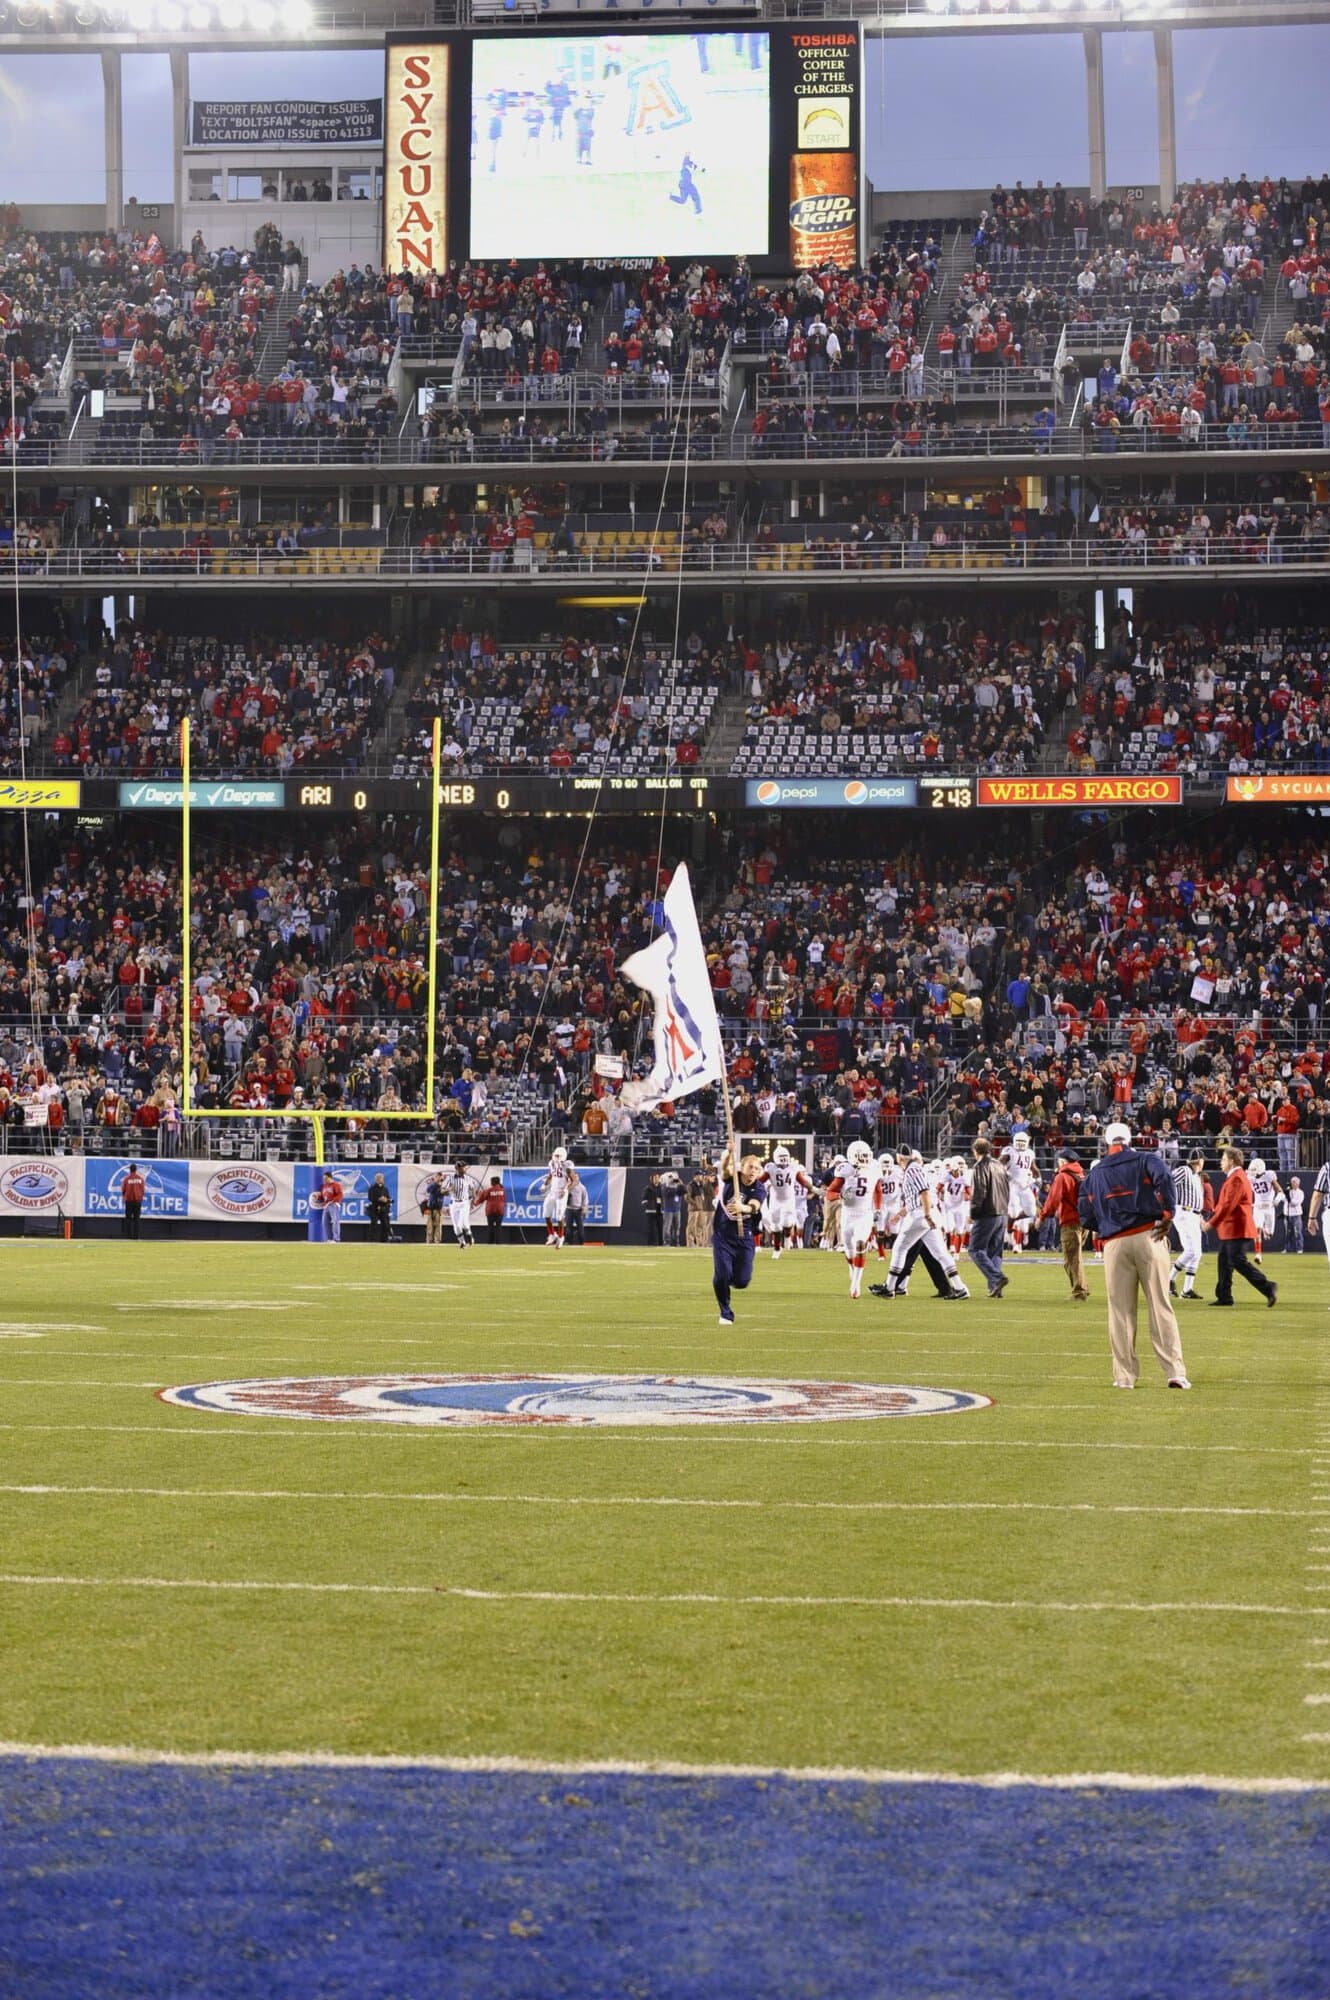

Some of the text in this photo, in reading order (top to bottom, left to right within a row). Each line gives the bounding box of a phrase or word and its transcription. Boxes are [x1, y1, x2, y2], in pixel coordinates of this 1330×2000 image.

[791, 34, 856, 46] TOSHIBA
[798, 48, 849, 58] OFFICIAL
[803, 60, 845, 70] COPIER
[803, 72, 846, 82] OF THE
[794, 84, 854, 94] CHARGERS
[206, 104, 248, 114] REPORT
[250, 104, 272, 114] FAN
[274, 103, 327, 114] CONDUCT
[200, 114, 374, 128] TEXT "BOLTSFAN" <space> YOUR
[202, 127, 372, 140] LOCATION AND ISSUE TO 41513
[397, 56, 434, 268] SYCUAN
[143, 207, 158, 217] 23
[801, 197, 850, 213] BUD
[793, 208, 856, 225] LIGHT
[574, 778, 602, 789] DOWN
[611, 778, 638, 789] TO GO
[645, 778, 682, 789] BALL ON
[690, 778, 708, 789] QTR
[988, 781, 1170, 800] WELLS FARGO
[0, 786, 60, 804] izza
[223, 788, 276, 804] Degree
[300, 786, 332, 805] ARI
[438, 785, 475, 804] NEB
[497, 790, 510, 809] 0
[782, 786, 818, 800] pepsi
[869, 786, 905, 800] pepsi
[354, 791, 367, 810] 0
[10, 1164, 58, 1179] PACIFIC LIFE
[218, 1169, 268, 1185] PACIFIC LIFE
[775, 1174, 792, 1188] 54
[856, 1177, 868, 1197] 5
[882, 1182, 896, 1194] 20
[1252, 1181, 1268, 1194] 23
[946, 1183, 962, 1196] 47
[4, 1189, 64, 1208] HOLIDAY BOWL
[88, 1193, 184, 1212] PACIC LIFE
[212, 1193, 270, 1212] HOLIDAY BOWL
